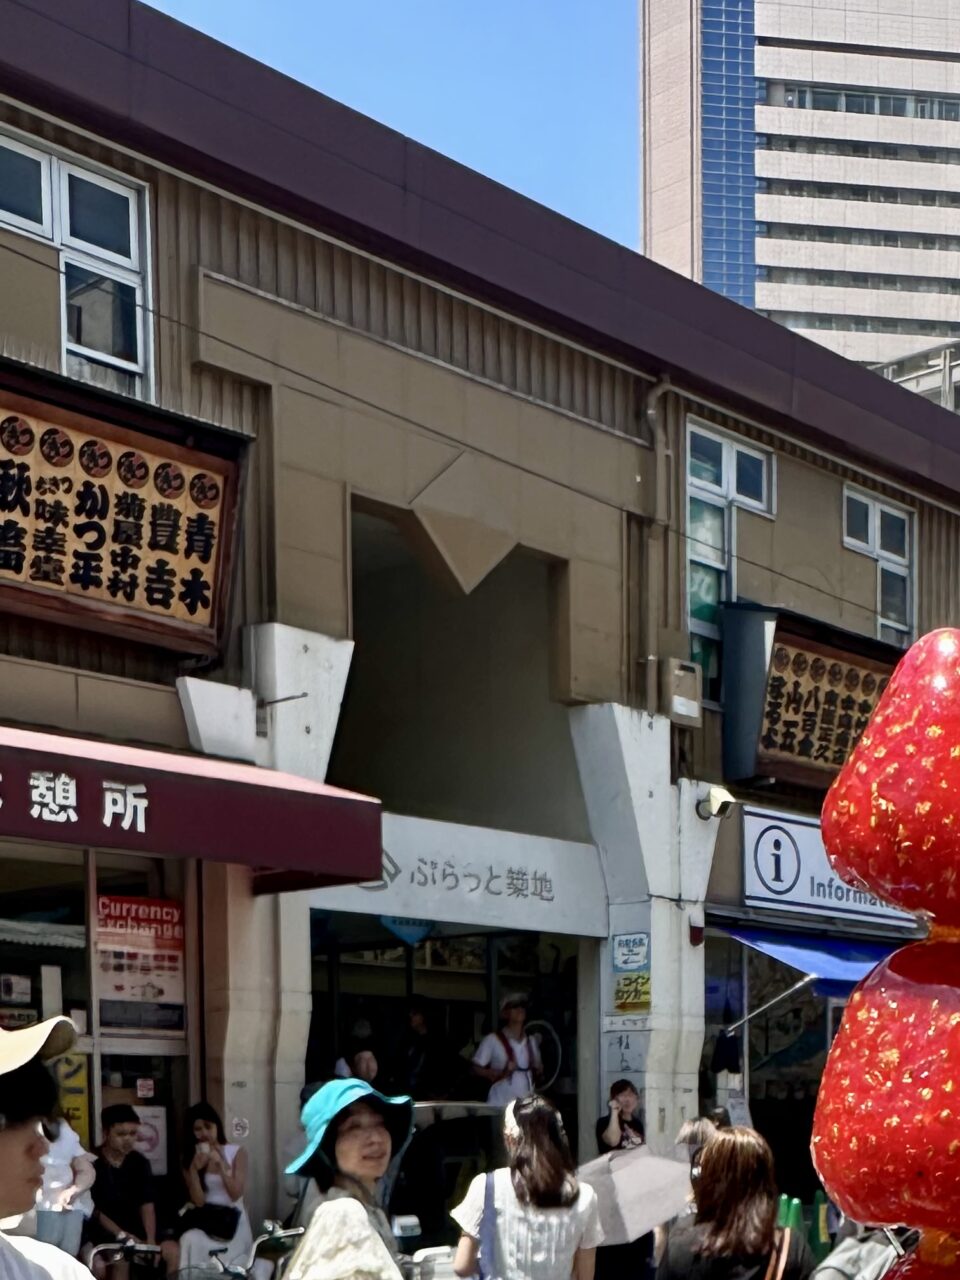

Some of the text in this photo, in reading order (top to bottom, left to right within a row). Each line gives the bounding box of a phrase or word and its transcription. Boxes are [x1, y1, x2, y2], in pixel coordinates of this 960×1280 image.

[178, 512, 216, 616] 青木
[0, 771, 148, 833] 憩所
[410, 858, 555, 902] ぷらっと築地
[810, 875, 900, 911] Informa
[98, 896, 181, 922] Currency
